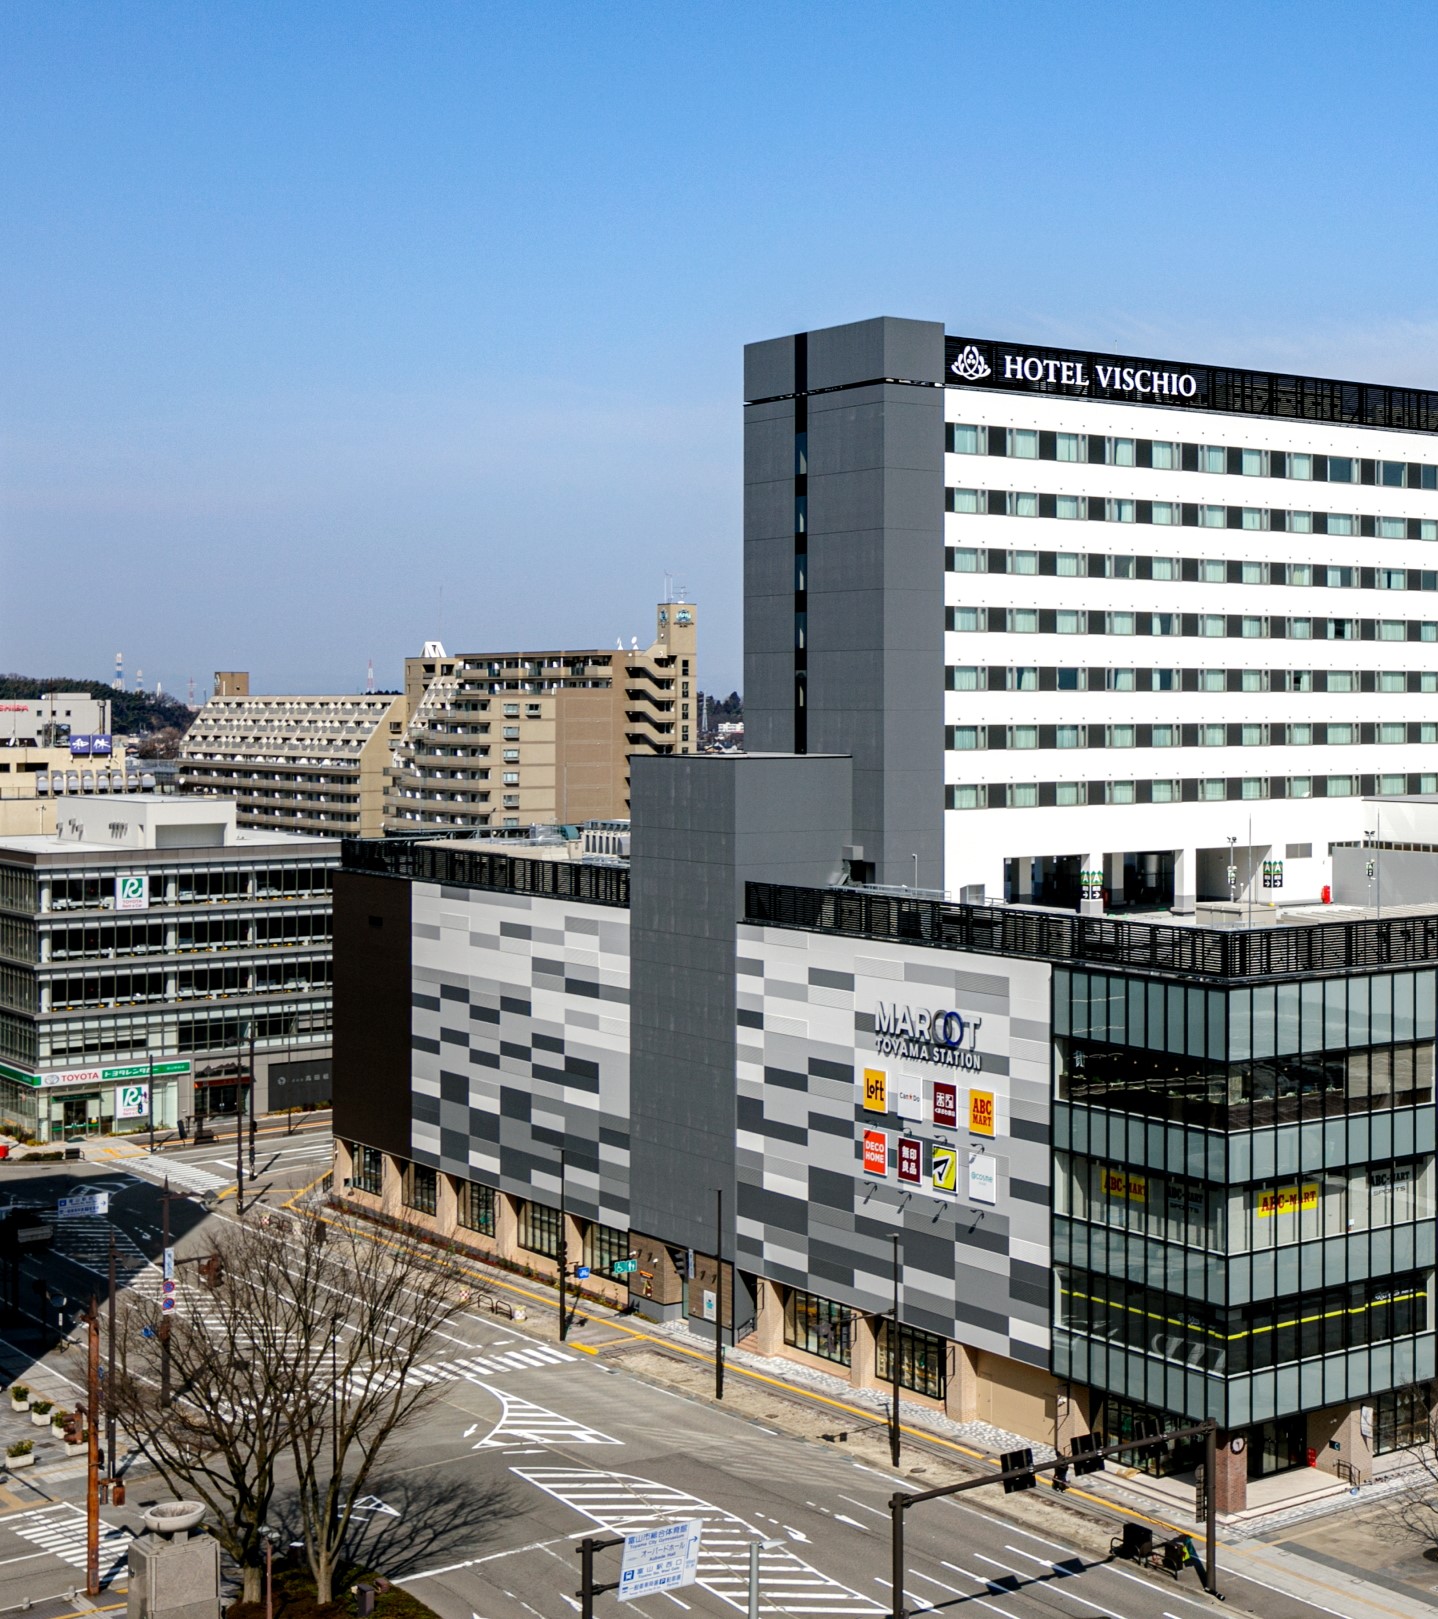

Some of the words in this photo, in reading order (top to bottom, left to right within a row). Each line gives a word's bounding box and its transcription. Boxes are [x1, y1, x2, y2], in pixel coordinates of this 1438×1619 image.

[1004, 355, 1090, 386] HOTEL
[1095, 365, 1197, 397] VISCHIO
[875, 1001, 982, 1052] MAROOT
[876, 1036, 929, 1060] TOYAMA
[933, 1047, 981, 1070] STATION
[61, 1072, 99, 1082] TOYOTA
[973, 1098, 992, 1115] ABC
[973, 1113, 992, 1127] MART
[865, 1140, 884, 1152] DECO
[902, 1146, 917, 1160] 無印
[865, 1151, 884, 1163] HOME
[902, 1160, 917, 1175] 良品
[1373, 1185, 1406, 1197] SPOTS
[628, 1524, 689, 1545] 富山市総合体育館
[641, 1542, 686, 1558] オーバードホール
[637, 1559, 682, 1574] 富山駅西口
